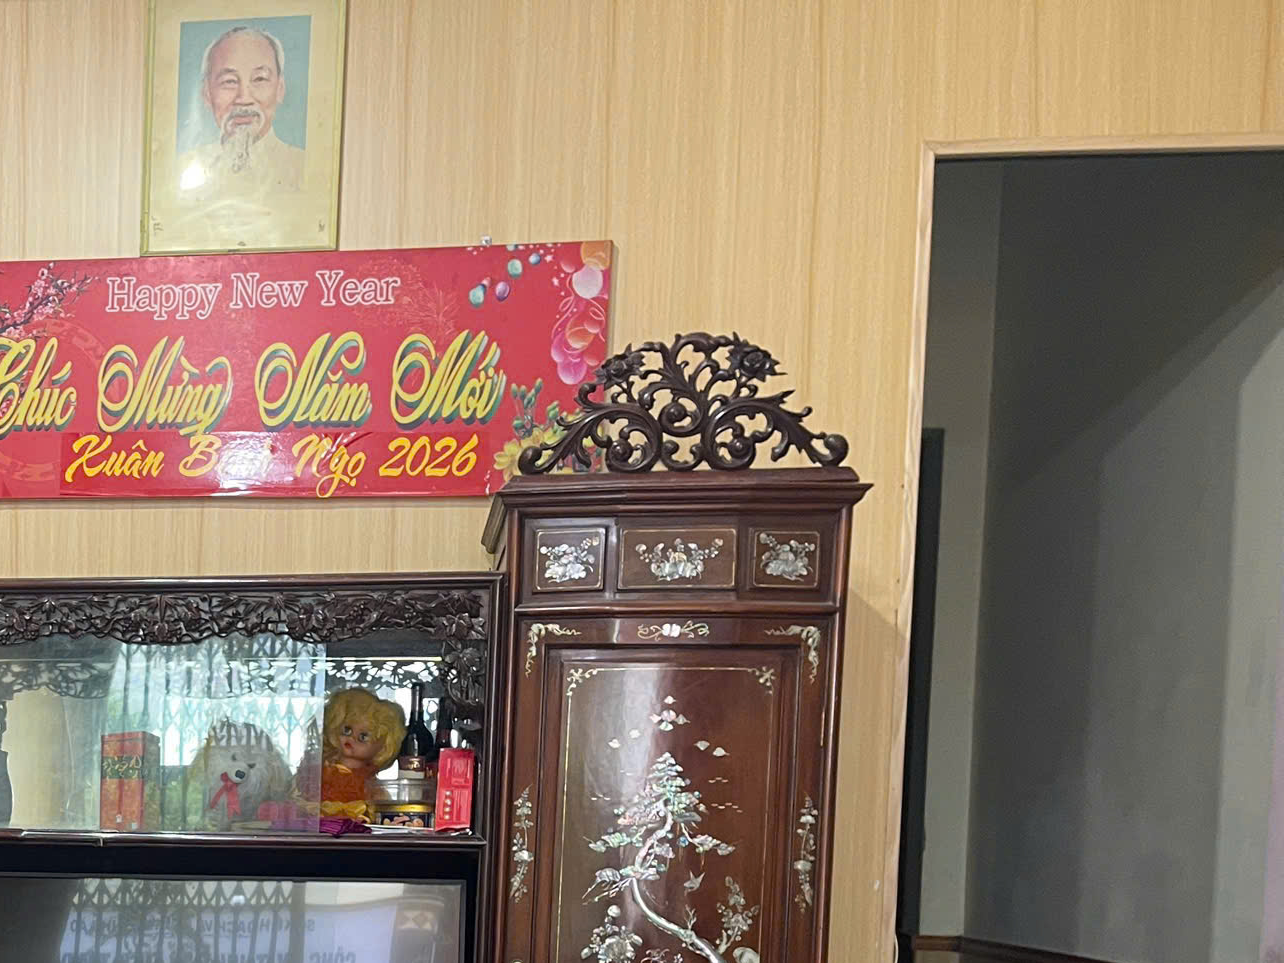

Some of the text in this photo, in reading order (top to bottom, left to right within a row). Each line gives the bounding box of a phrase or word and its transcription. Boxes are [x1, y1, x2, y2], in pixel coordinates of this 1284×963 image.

[106, 270, 401, 320] Happy New Year
[96, 335, 233, 437] Mừng
[254, 330, 372, 429] Năm
[390, 329, 506, 427] Mới
[291, 431, 367, 499] Ngọ
[378, 433, 479, 478] 2026
